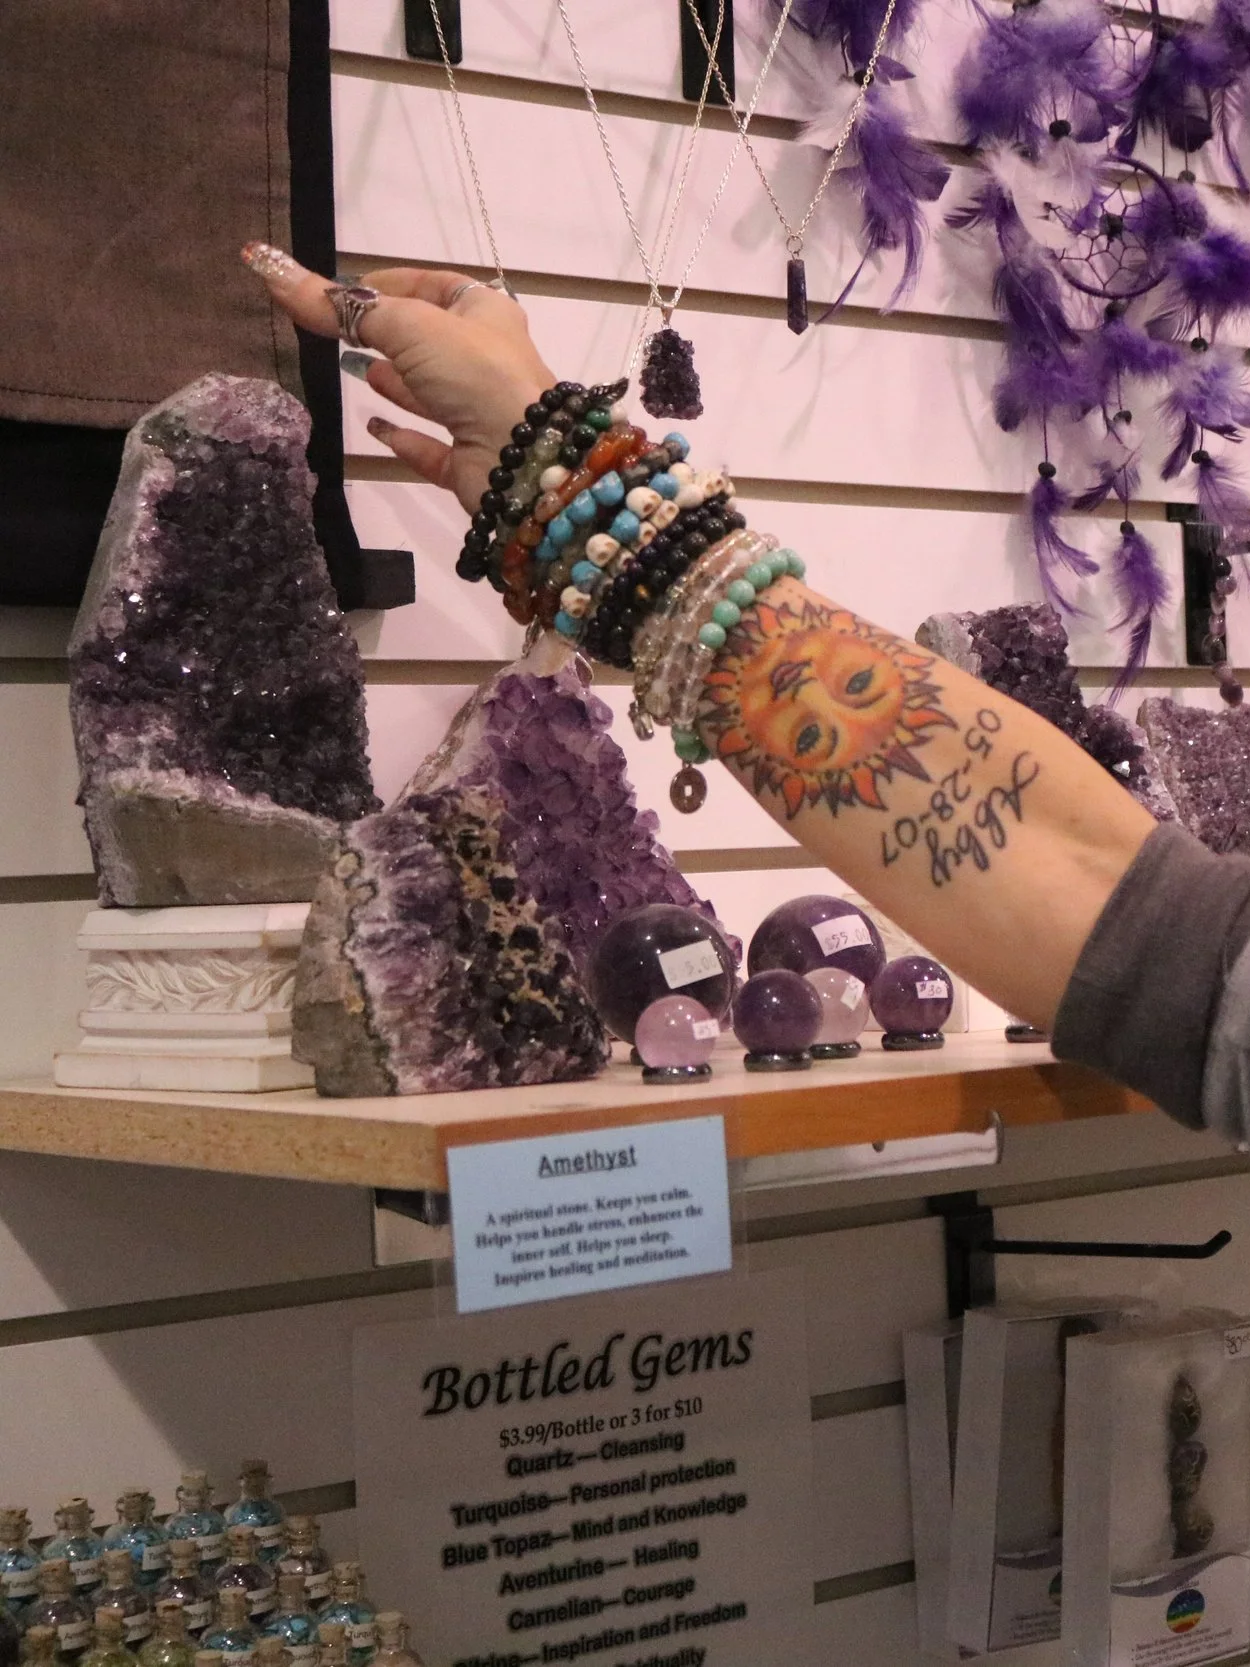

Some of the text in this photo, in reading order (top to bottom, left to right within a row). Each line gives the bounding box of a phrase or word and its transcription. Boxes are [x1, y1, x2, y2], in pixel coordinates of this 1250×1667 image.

[925, 751, 1040, 887] Abby
[538, 1145, 637, 1177] Amethyst
[475, 1232, 513, 1250] Helps
[515, 1229, 540, 1244] you
[542, 1219, 583, 1240] handle
[628, 1208, 682, 1227] enhances
[685, 1204, 704, 1218] the
[485, 1213, 496, 1226] A
[499, 1205, 554, 1226] spiritual
[596, 1195, 633, 1213] Keeps
[635, 1192, 658, 1208] you
[512, 1249, 545, 1264] inner
[576, 1238, 613, 1255] Helps
[615, 1235, 638, 1250] you
[494, 1265, 546, 1287] Inspires
[549, 1258, 594, 1278] healing
[597, 1255, 620, 1270] and
[422, 1328, 754, 1417] Bottled Gems
[499, 1397, 704, 1449] $3.99/Bottle or 3 for $10
[650, 1457, 736, 1493] protection
[441, 1543, 489, 1570] Blue
[617, 1508, 650, 1532] and
[653, 1491, 748, 1525] Knowledge
[633, 1537, 700, 1568] Healing
[639, 1614, 670, 1641] and
[674, 1600, 748, 1633] Freedom
